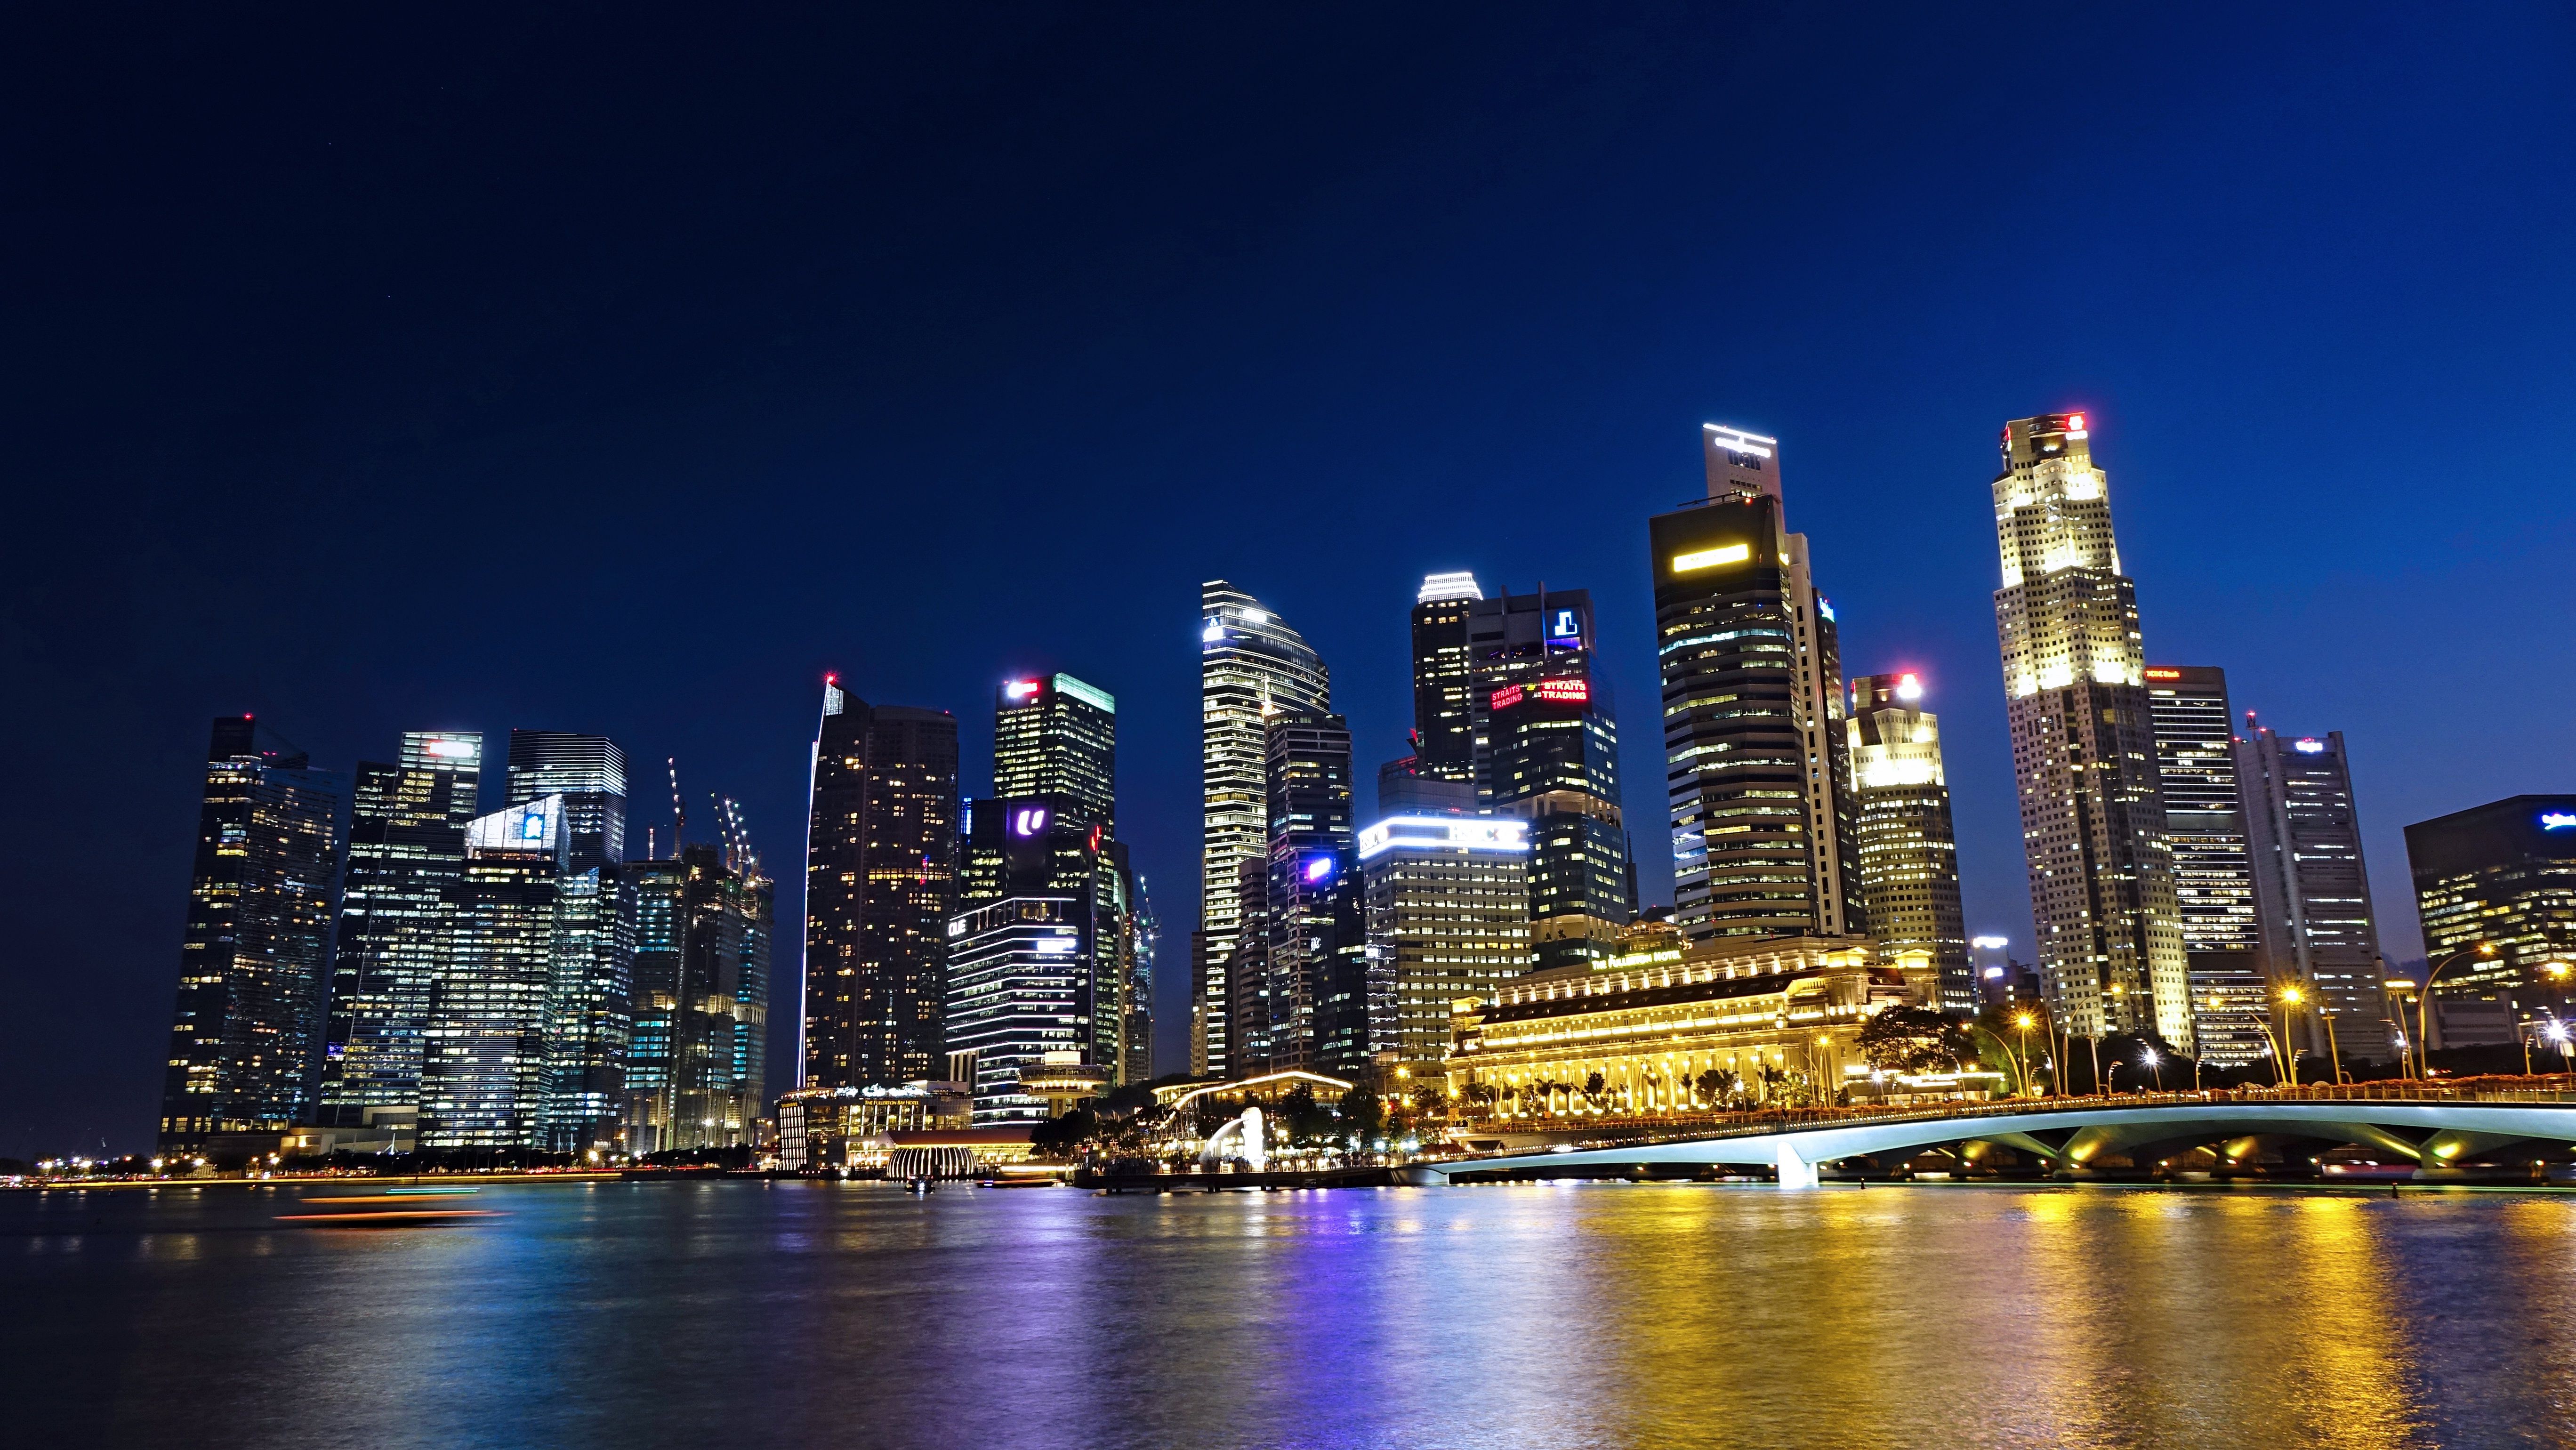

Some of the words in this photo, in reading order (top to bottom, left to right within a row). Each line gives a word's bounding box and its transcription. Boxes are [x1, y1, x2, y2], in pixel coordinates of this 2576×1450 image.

[1492, 685, 1520, 701] STRAITS
[1544, 682, 1586, 691] STRAITS
[1492, 693, 1523, 709] TRADING
[1542, 691, 1586, 700] TRADING
[948, 919, 966, 936] OUE
[1653, 950, 1682, 962] HOTEL
